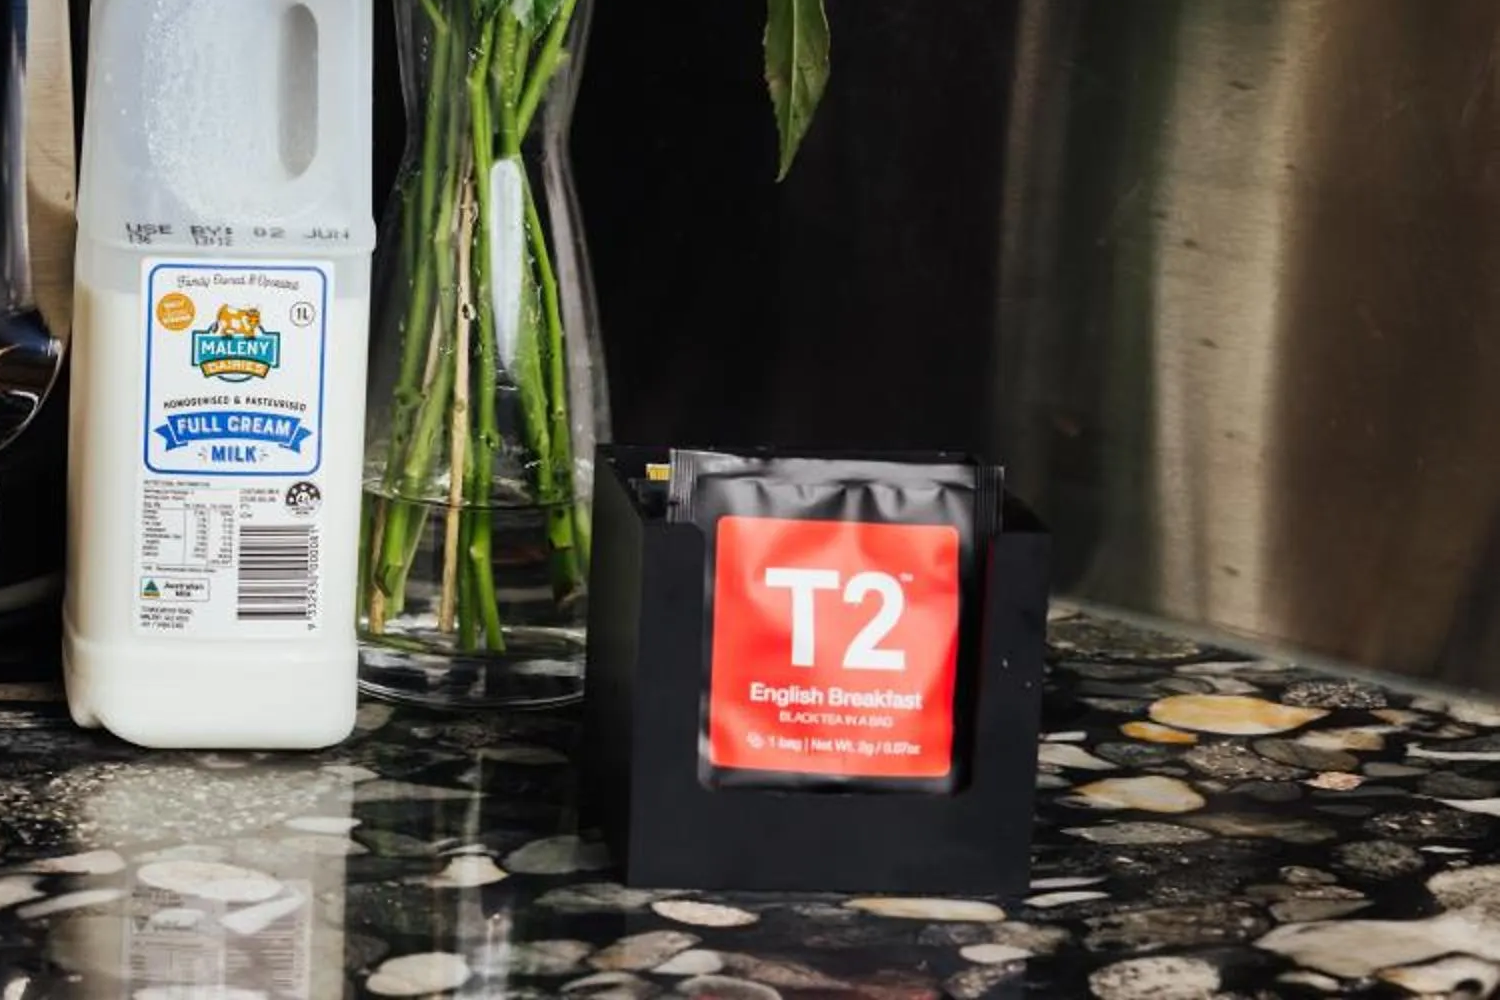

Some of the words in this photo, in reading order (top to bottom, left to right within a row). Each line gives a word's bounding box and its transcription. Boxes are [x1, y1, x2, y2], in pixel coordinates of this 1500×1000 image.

[125, 223, 174, 235] USE
[253, 227, 285, 239] 02
[304, 227, 349, 239] JUN
[201, 340, 269, 355] MALENY
[163, 396, 229, 409] HOMOGENISED
[245, 396, 307, 411] PASTEURISED
[177, 416, 223, 435] FULL
[227, 415, 292, 437] CREAM
[211, 446, 257, 463] MILK
[765, 567, 905, 670] T2
[750, 682, 824, 707] English
[828, 687, 923, 710] Breakfast
[779, 710, 818, 724] BLACK
[820, 713, 843, 725] TEA
[812, 736, 834, 751] Net
